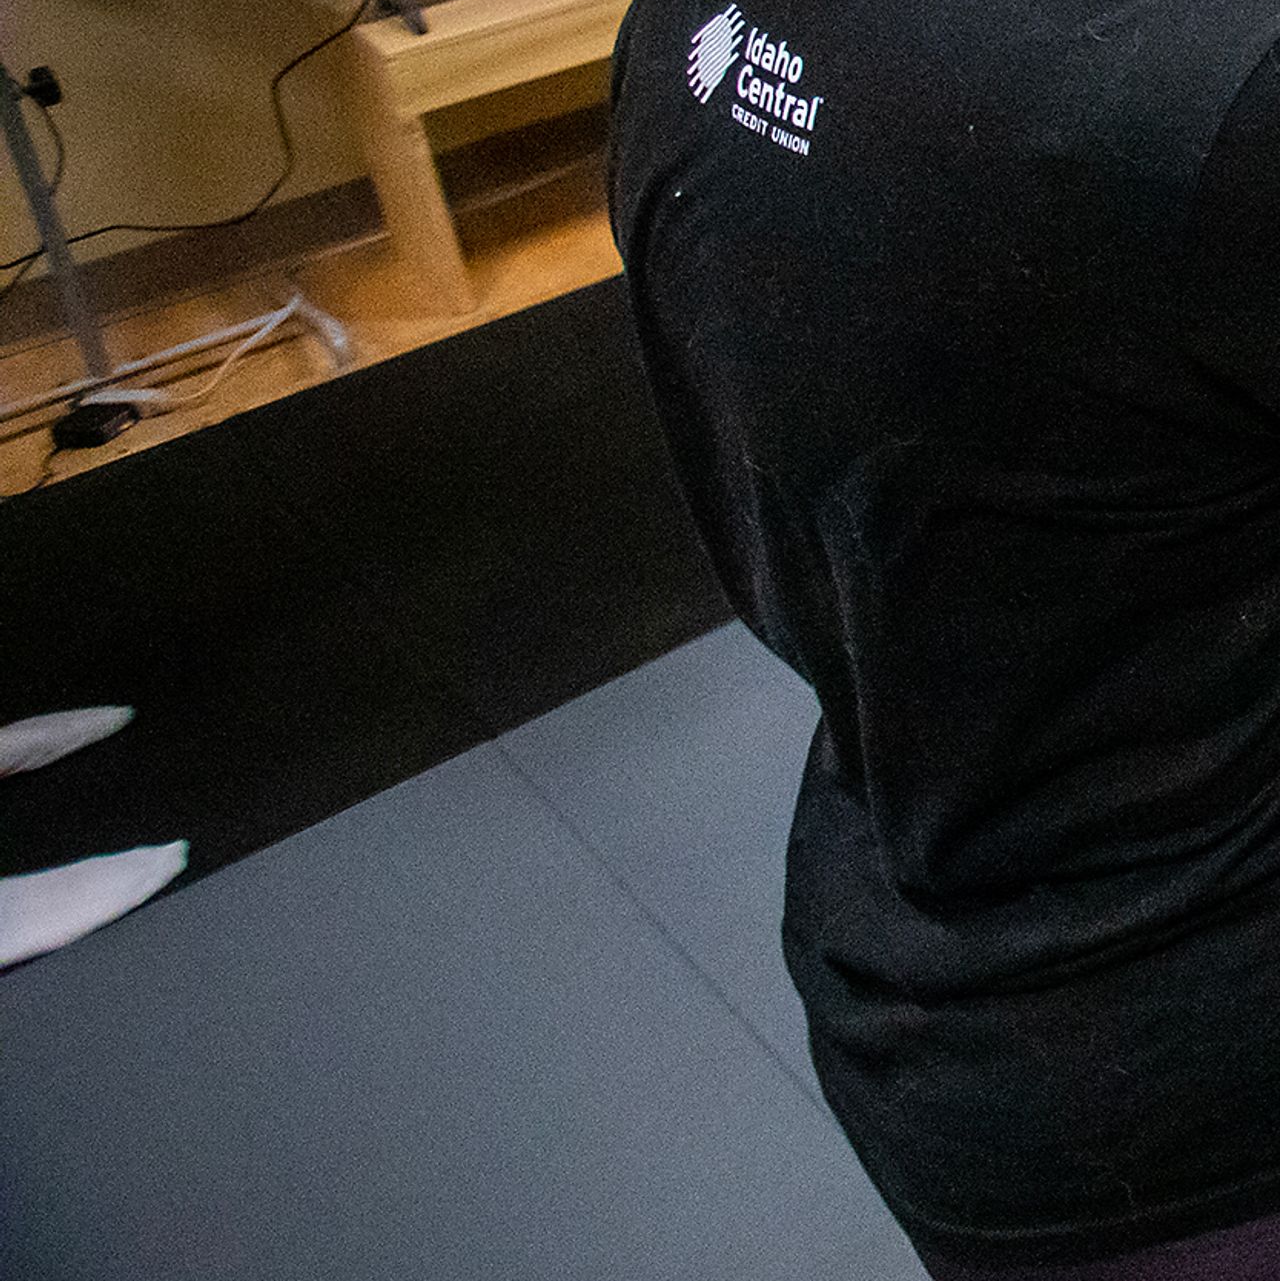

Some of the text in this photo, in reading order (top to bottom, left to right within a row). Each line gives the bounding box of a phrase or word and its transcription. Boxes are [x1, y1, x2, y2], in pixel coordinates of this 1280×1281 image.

[746, 27, 803, 83] Idaho
[737, 65, 819, 131] Central
[732, 104, 810, 156] CREDIT UNION
